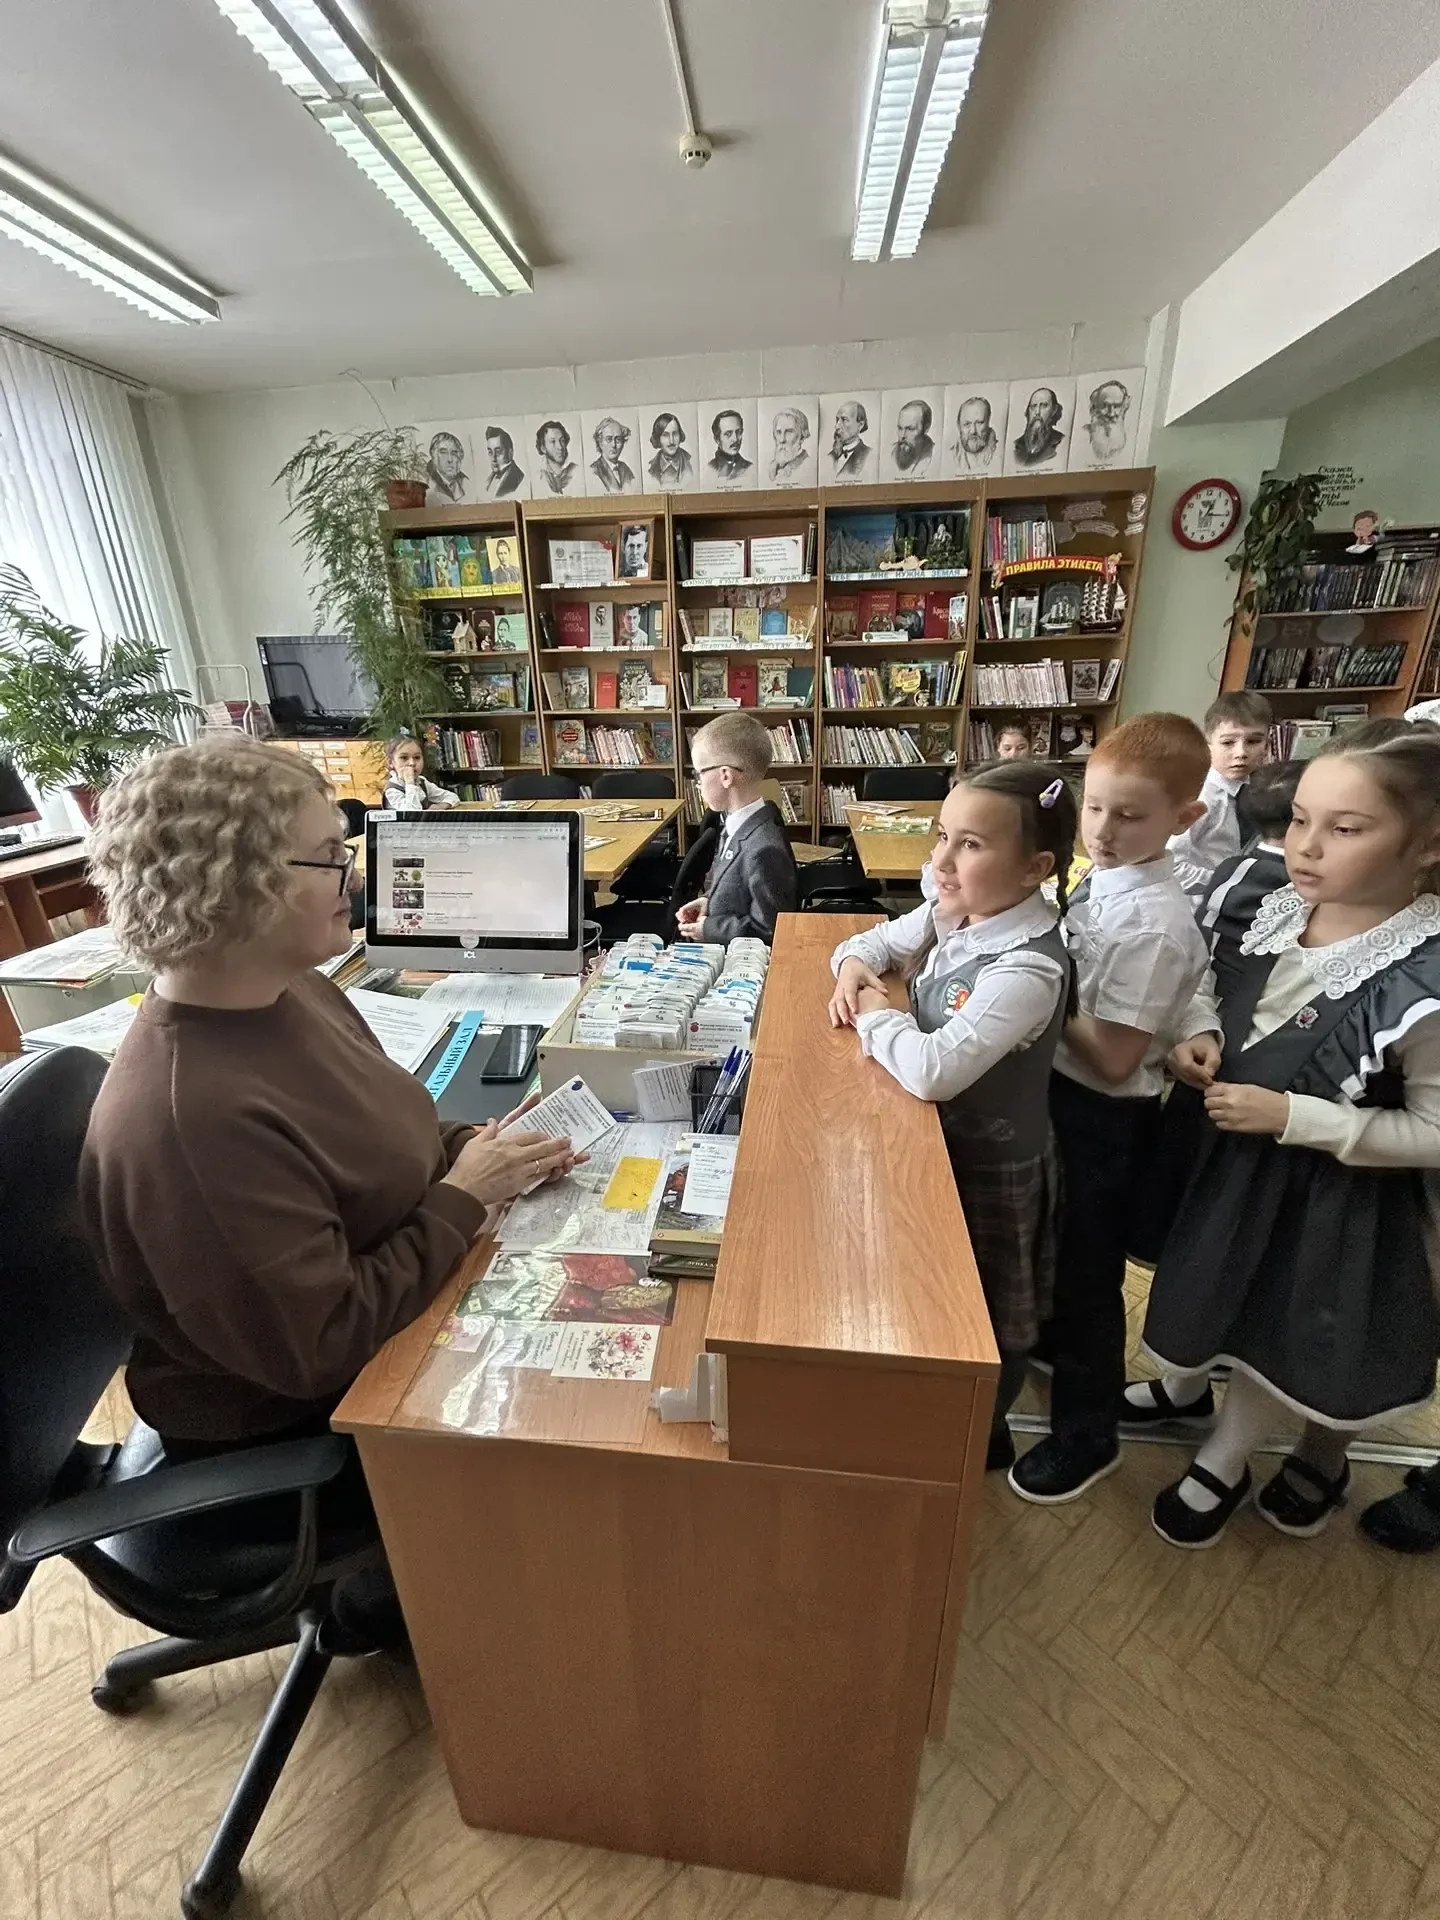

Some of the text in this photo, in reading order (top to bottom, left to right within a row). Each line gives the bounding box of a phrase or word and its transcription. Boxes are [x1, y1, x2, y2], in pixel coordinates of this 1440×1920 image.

[1005, 558, 1104, 576] ПРАВИЛА ЭТИКЕТА
[831, 573, 849, 581] ТЕБЕ
[895, 570, 926, 578] НУЖНА
[931, 569, 961, 577] ЗЕМЛЯ
[463, 950, 477, 959] ICL
[430, 1027, 473, 1095] ТАЛЬНЫЙ ЗАЛ
